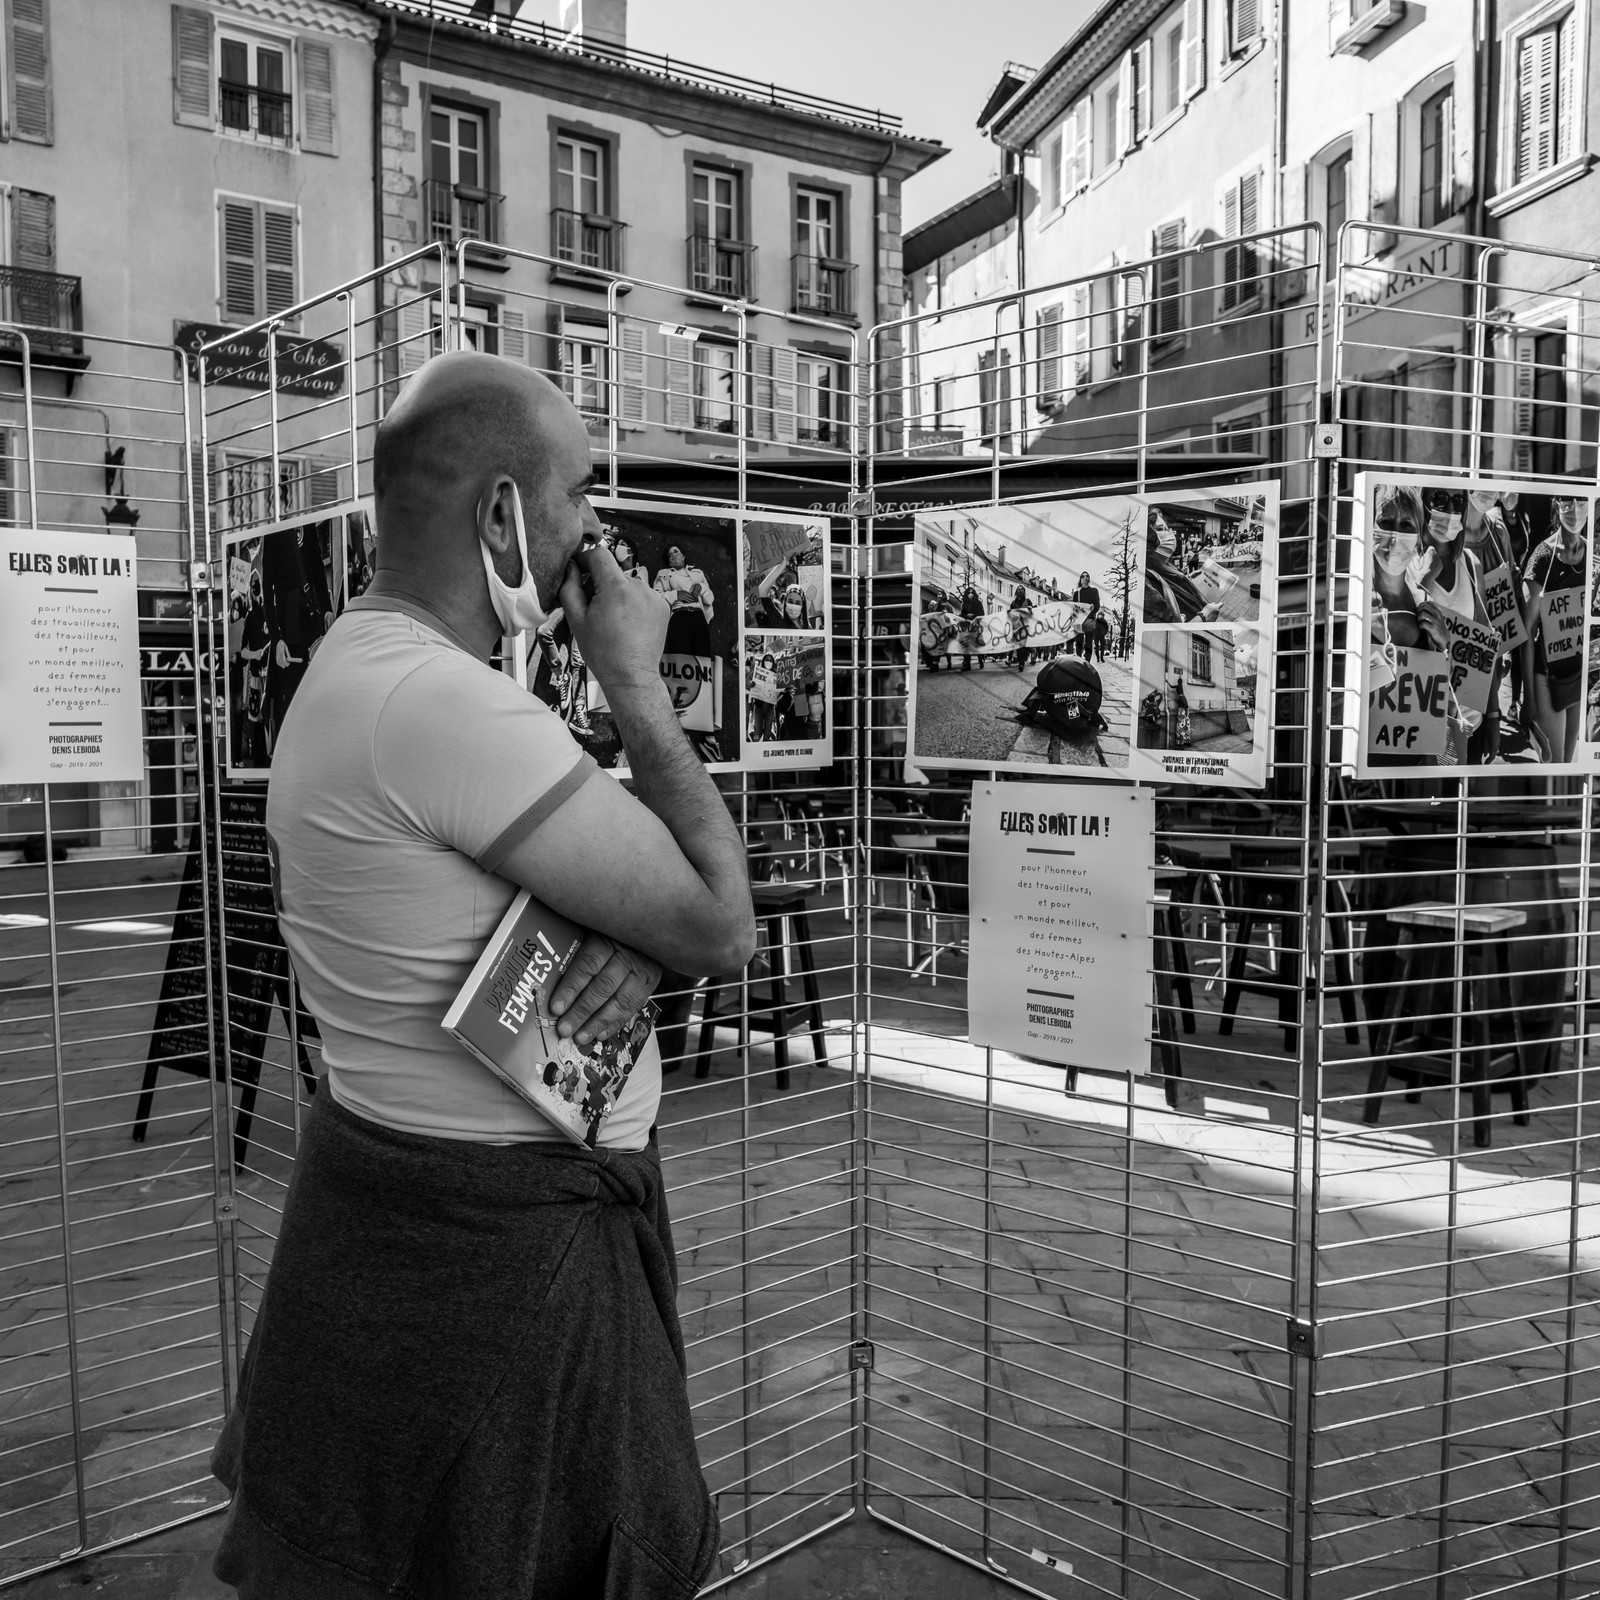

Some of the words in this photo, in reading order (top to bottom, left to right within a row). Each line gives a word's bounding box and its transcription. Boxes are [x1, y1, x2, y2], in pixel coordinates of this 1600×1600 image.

[9, 552, 52, 576] ELLES
[57, 554, 98, 576] SONT
[103, 557, 121, 576] LA
[125, 559, 131, 577] !
[38, 605, 61, 614] pour
[65, 605, 112, 614] l'honneur
[1548, 594, 1571, 617] APF
[30, 618, 48, 626] des
[52, 618, 119, 629] travailleuses,
[34, 631, 51, 640] des
[56, 631, 117, 642] travailleurs,
[58, 645, 68, 653] et
[72, 646, 95, 655] pour
[44, 658, 77, 667] monde
[81, 659, 124, 669] meilleur,
[48, 671, 65, 680] des
[69, 671, 106, 680] femmes
[33, 684, 50, 693] des
[54, 685, 121, 696] Hautes-Alpes
[1370, 672, 1449, 718] REVE
[46, 698, 110, 711] s'engagent...
[48, 735, 103, 744] PHOTOGRAPHIES
[1375, 724, 1420, 749] APF
[51, 746, 72, 755] DENIS
[72, 745, 101, 754] LEBIODA
[1201, 767, 1224, 776] FEMMES
[1000, 811, 1035, 836] ELLES
[1038, 812, 1078, 836] SONT
[1081, 815, 1100, 836] LA
[1104, 816, 1110, 838] !
[1021, 865, 1041, 874] pour
[1044, 865, 1087, 876] l'honneur
[1017, 880, 1032, 888] des
[1036, 881, 1092, 896] travailleurs,
[1038, 898, 1047, 907] et
[1050, 901, 1071, 910] pour
[1027, 915, 1055, 924] monde
[1058, 918, 1099, 931] meilleur,
[1029, 930, 1045, 940] des
[1048, 932, 1082, 945] femmes
[1016, 946, 1031, 955] des
[1034, 948, 1096, 964] Hautes-Alpes
[482, 945, 525, 1013] DEBOUT
[519, 938, 538, 961] LES
[1026, 964, 1083, 981] s'engagent...
[1026, 1002, 1075, 1019] PHOTOGRAPHIES
[1028, 1014, 1047, 1025] DENIS
[1046, 1017, 1072, 1030] LEBIODA
[1027, 1030, 1039, 1039] Gap
[1042, 1033, 1057, 1042] 2019
[1060, 1036, 1074, 1045] 2021
